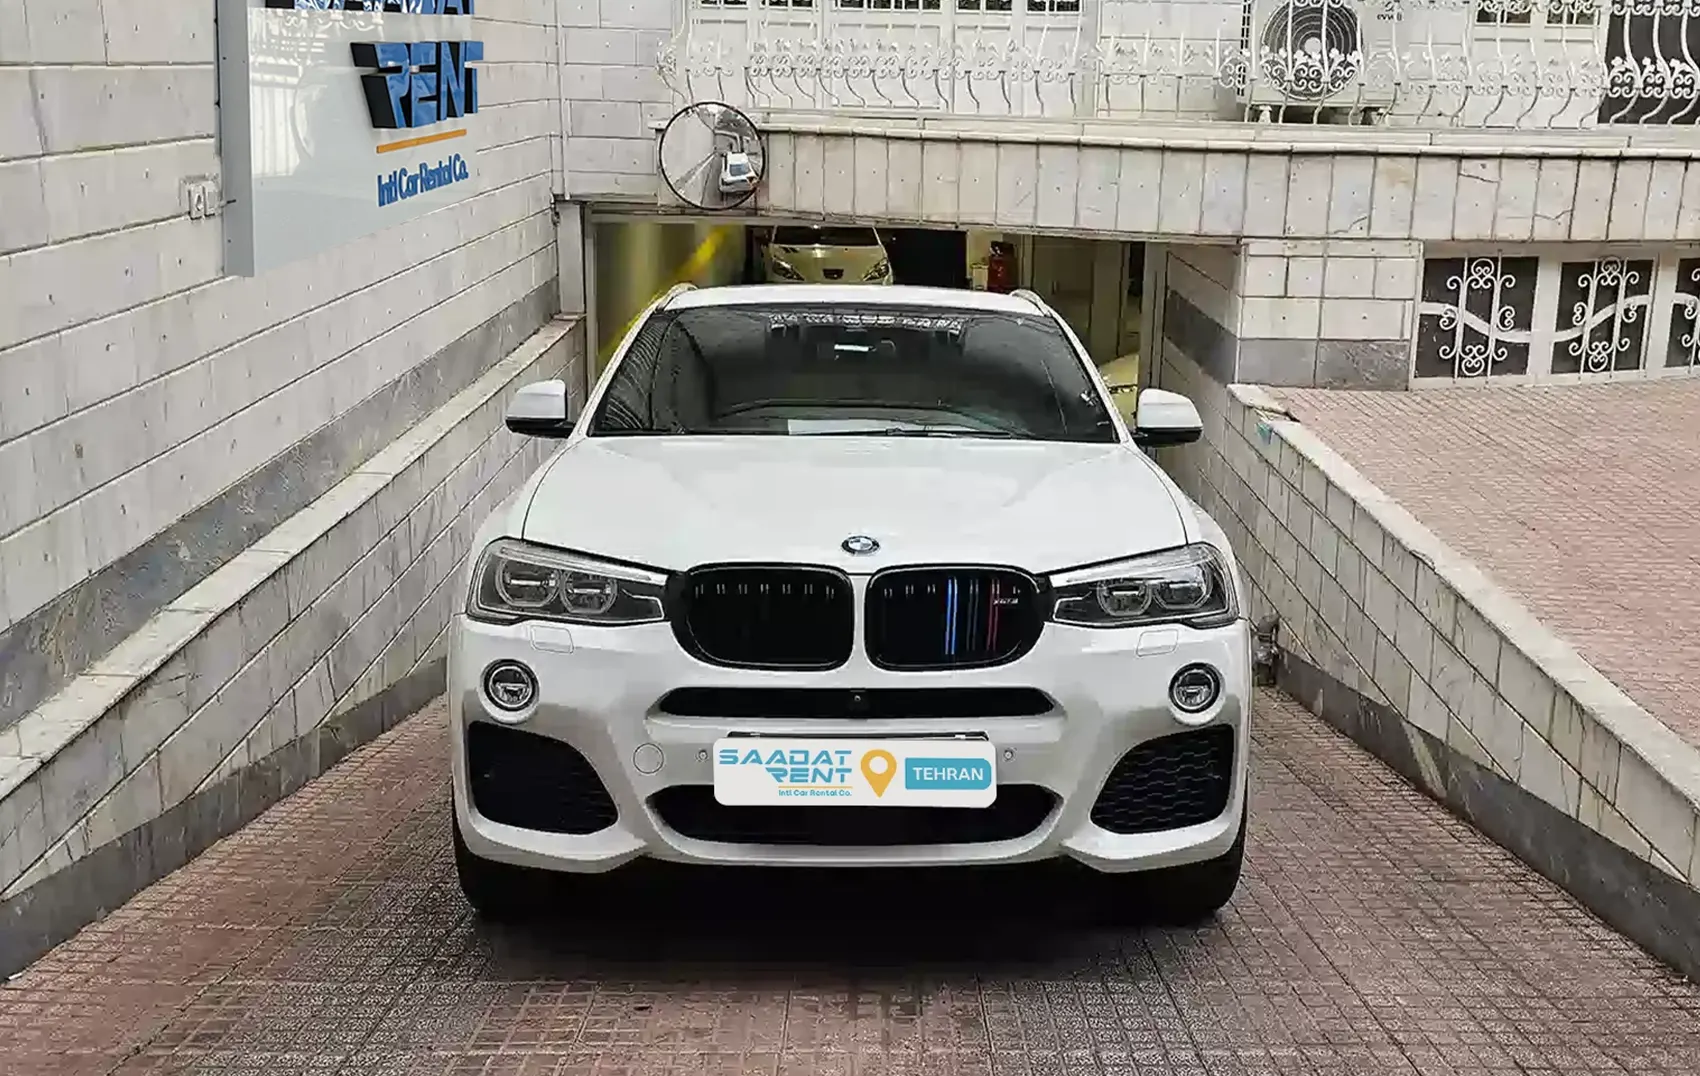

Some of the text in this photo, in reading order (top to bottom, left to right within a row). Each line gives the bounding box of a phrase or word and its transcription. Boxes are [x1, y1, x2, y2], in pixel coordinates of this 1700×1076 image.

[352, 41, 484, 129] RENT
[398, 168, 419, 200] Car
[419, 155, 453, 193] Rental
[453, 153, 469, 182] Co.
[719, 749, 852, 766] SAADAT
[765, 767, 852, 783] RENT
[912, 766, 984, 781] TEHRAN
[793, 789, 808, 797] Car
[810, 789, 837, 797] Rental
[838, 789, 852, 797] Co.
